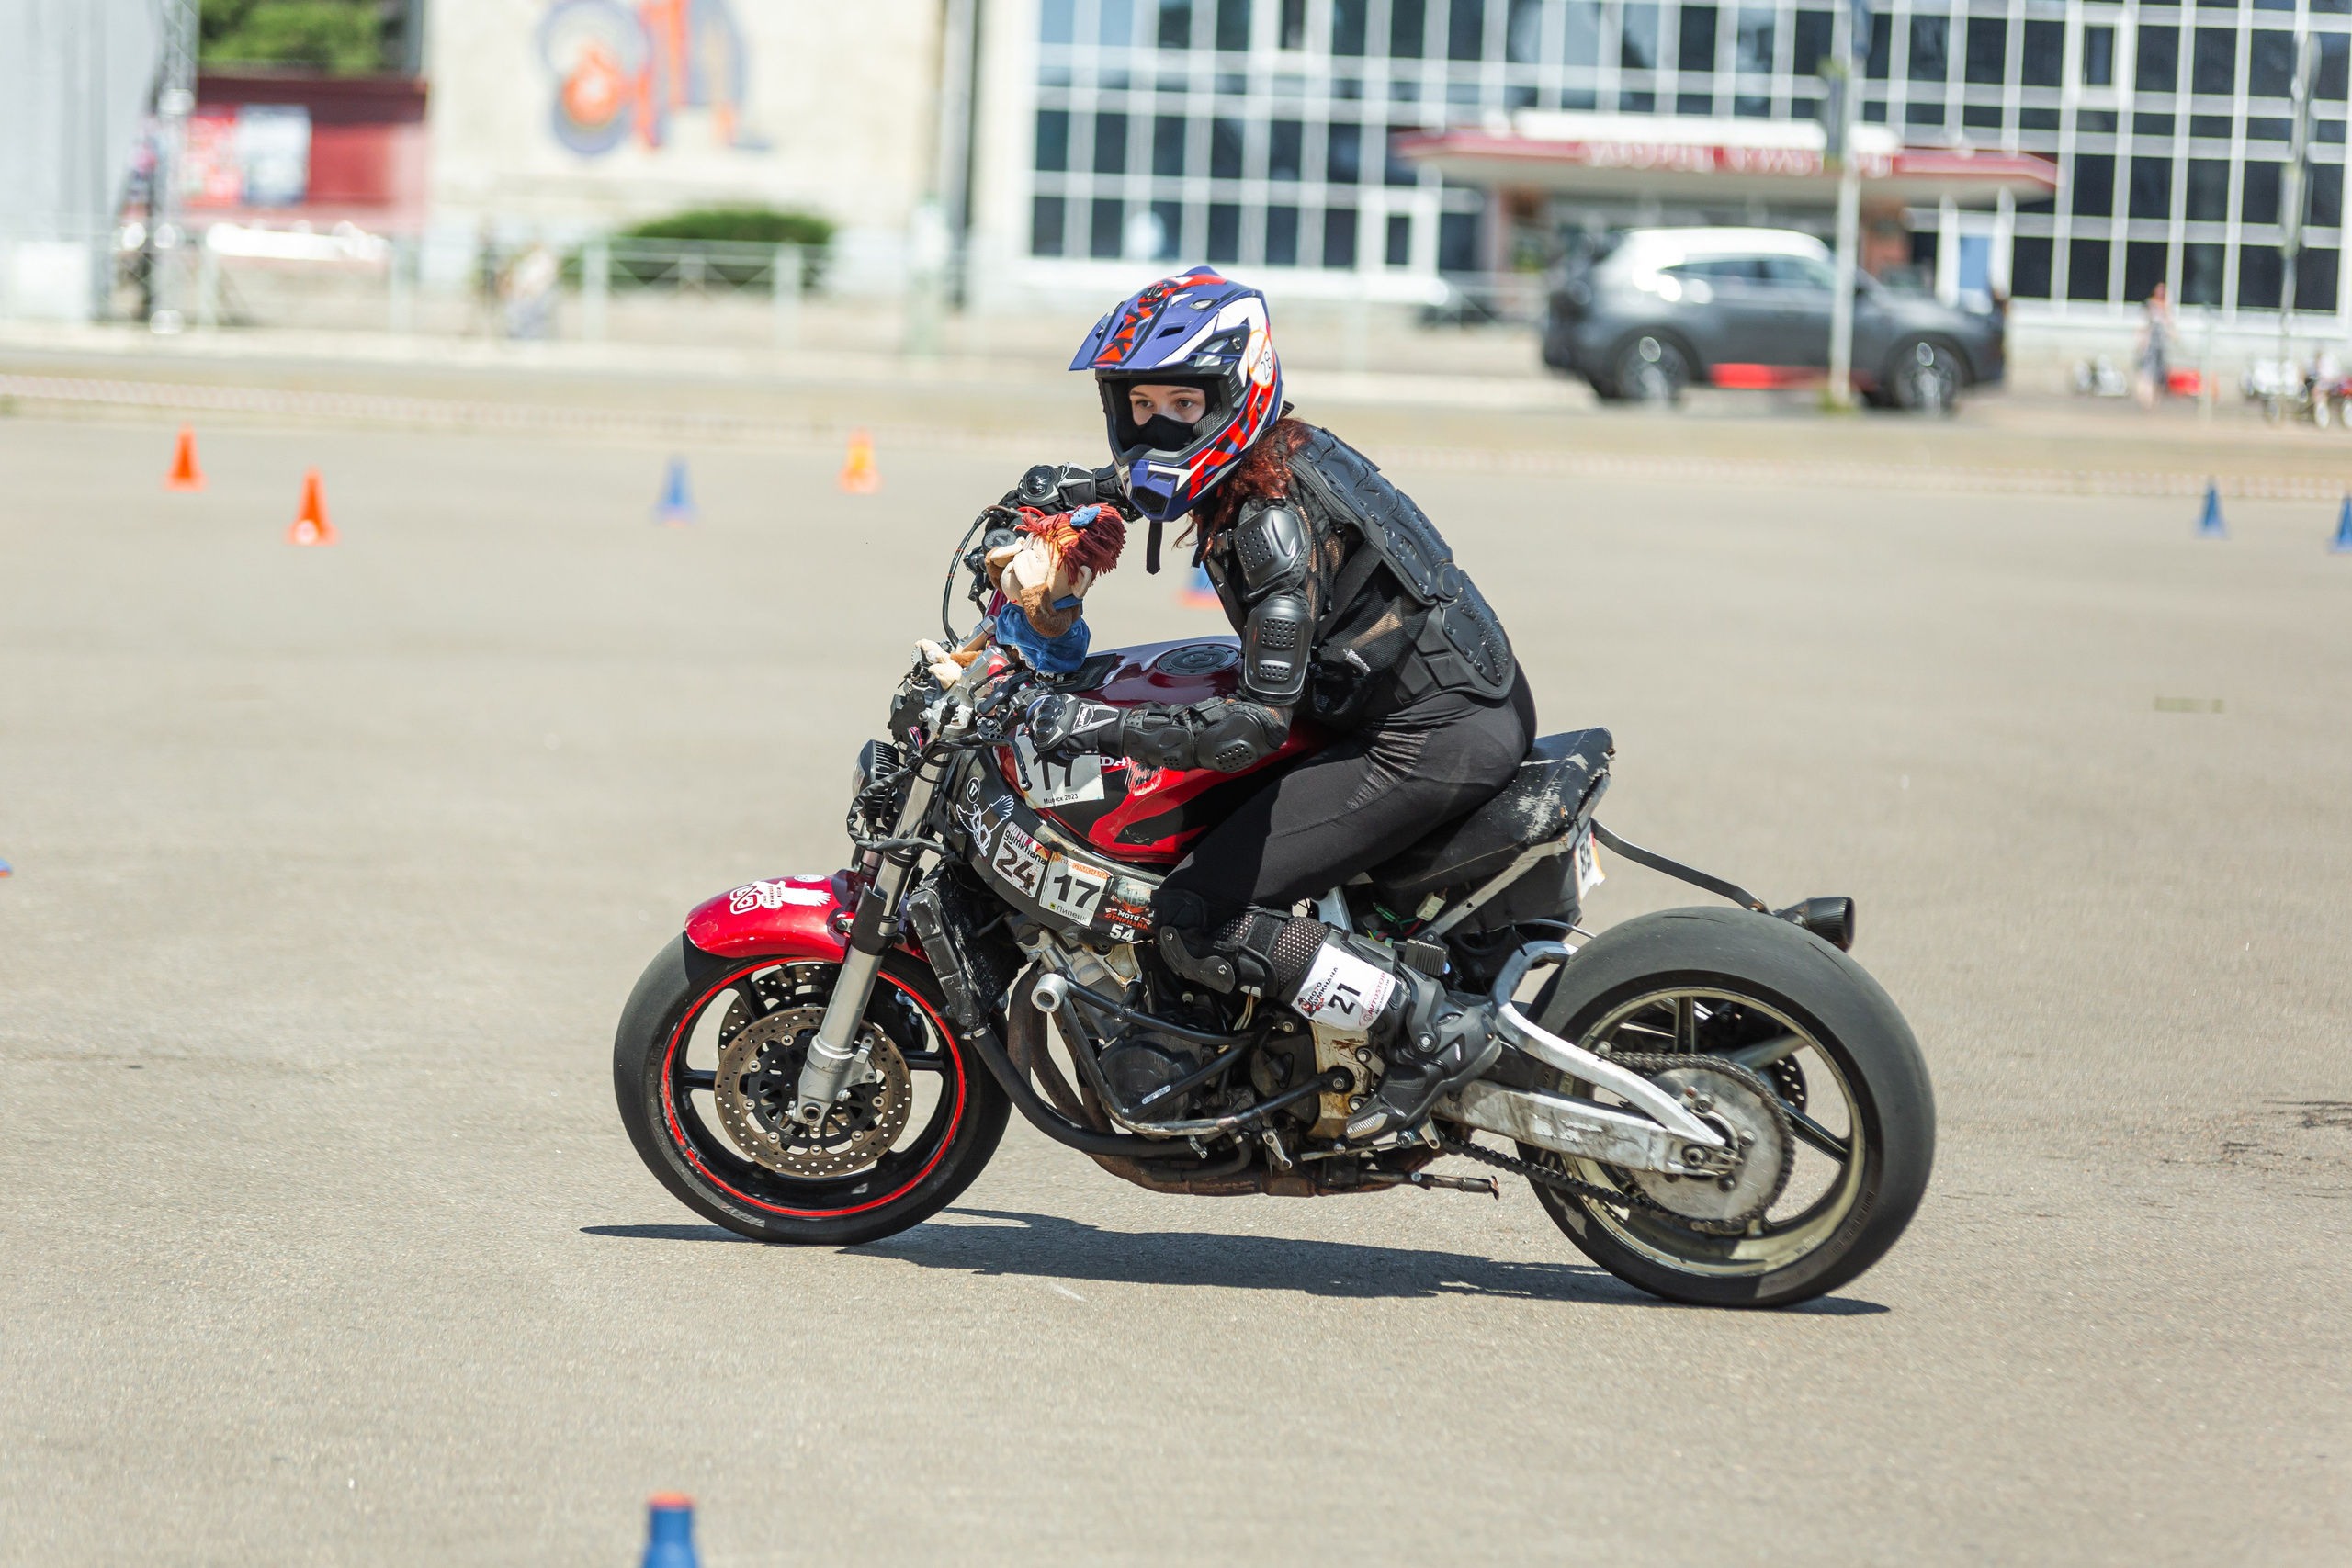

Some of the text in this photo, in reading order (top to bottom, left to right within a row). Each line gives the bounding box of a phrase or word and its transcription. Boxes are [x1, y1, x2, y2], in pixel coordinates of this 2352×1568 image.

[1064, 793, 1079, 801] 2023
[1003, 829, 1047, 865] gymkhana
[996, 841, 1035, 890] 24
[1053, 874, 1101, 908] 17
[1056, 904, 1088, 922] Липецк
[1104, 912, 1148, 930] GYMKHANA
[1117, 909, 1140, 921] MOTO
[1109, 923, 1136, 942] 54
[1308, 981, 1322, 1003] MOTO
[1327, 982, 1362, 1015] 21
[1368, 972, 1385, 1016] AVTOSTOP
